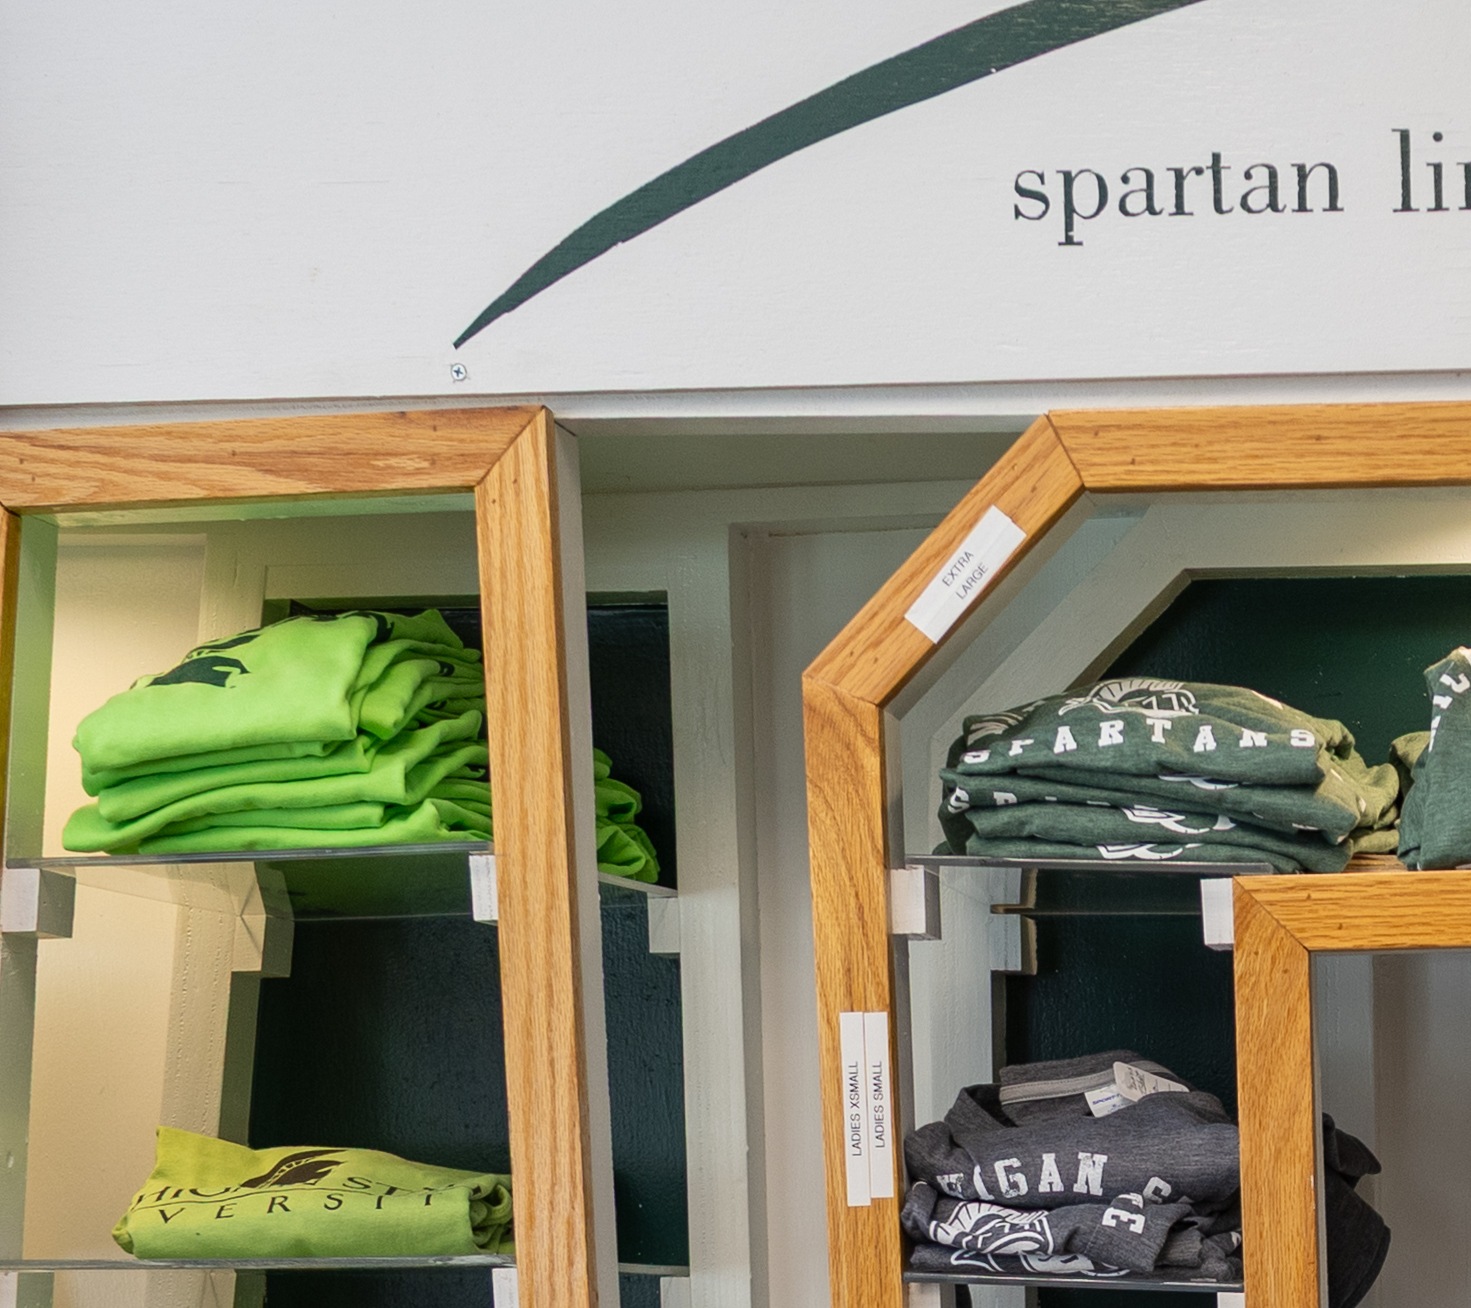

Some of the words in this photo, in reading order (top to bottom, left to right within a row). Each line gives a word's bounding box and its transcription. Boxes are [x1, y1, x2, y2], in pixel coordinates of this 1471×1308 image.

[1013, 151, 1345, 247] spartan
[941, 547, 977, 588] EXTRA
[953, 560, 988, 600] LARGE
[848, 1061, 860, 1109] XSMALL
[872, 1061, 884, 1101] SMALL
[849, 1113, 863, 1157] LADIES
[873, 1104, 886, 1149] LADIES
